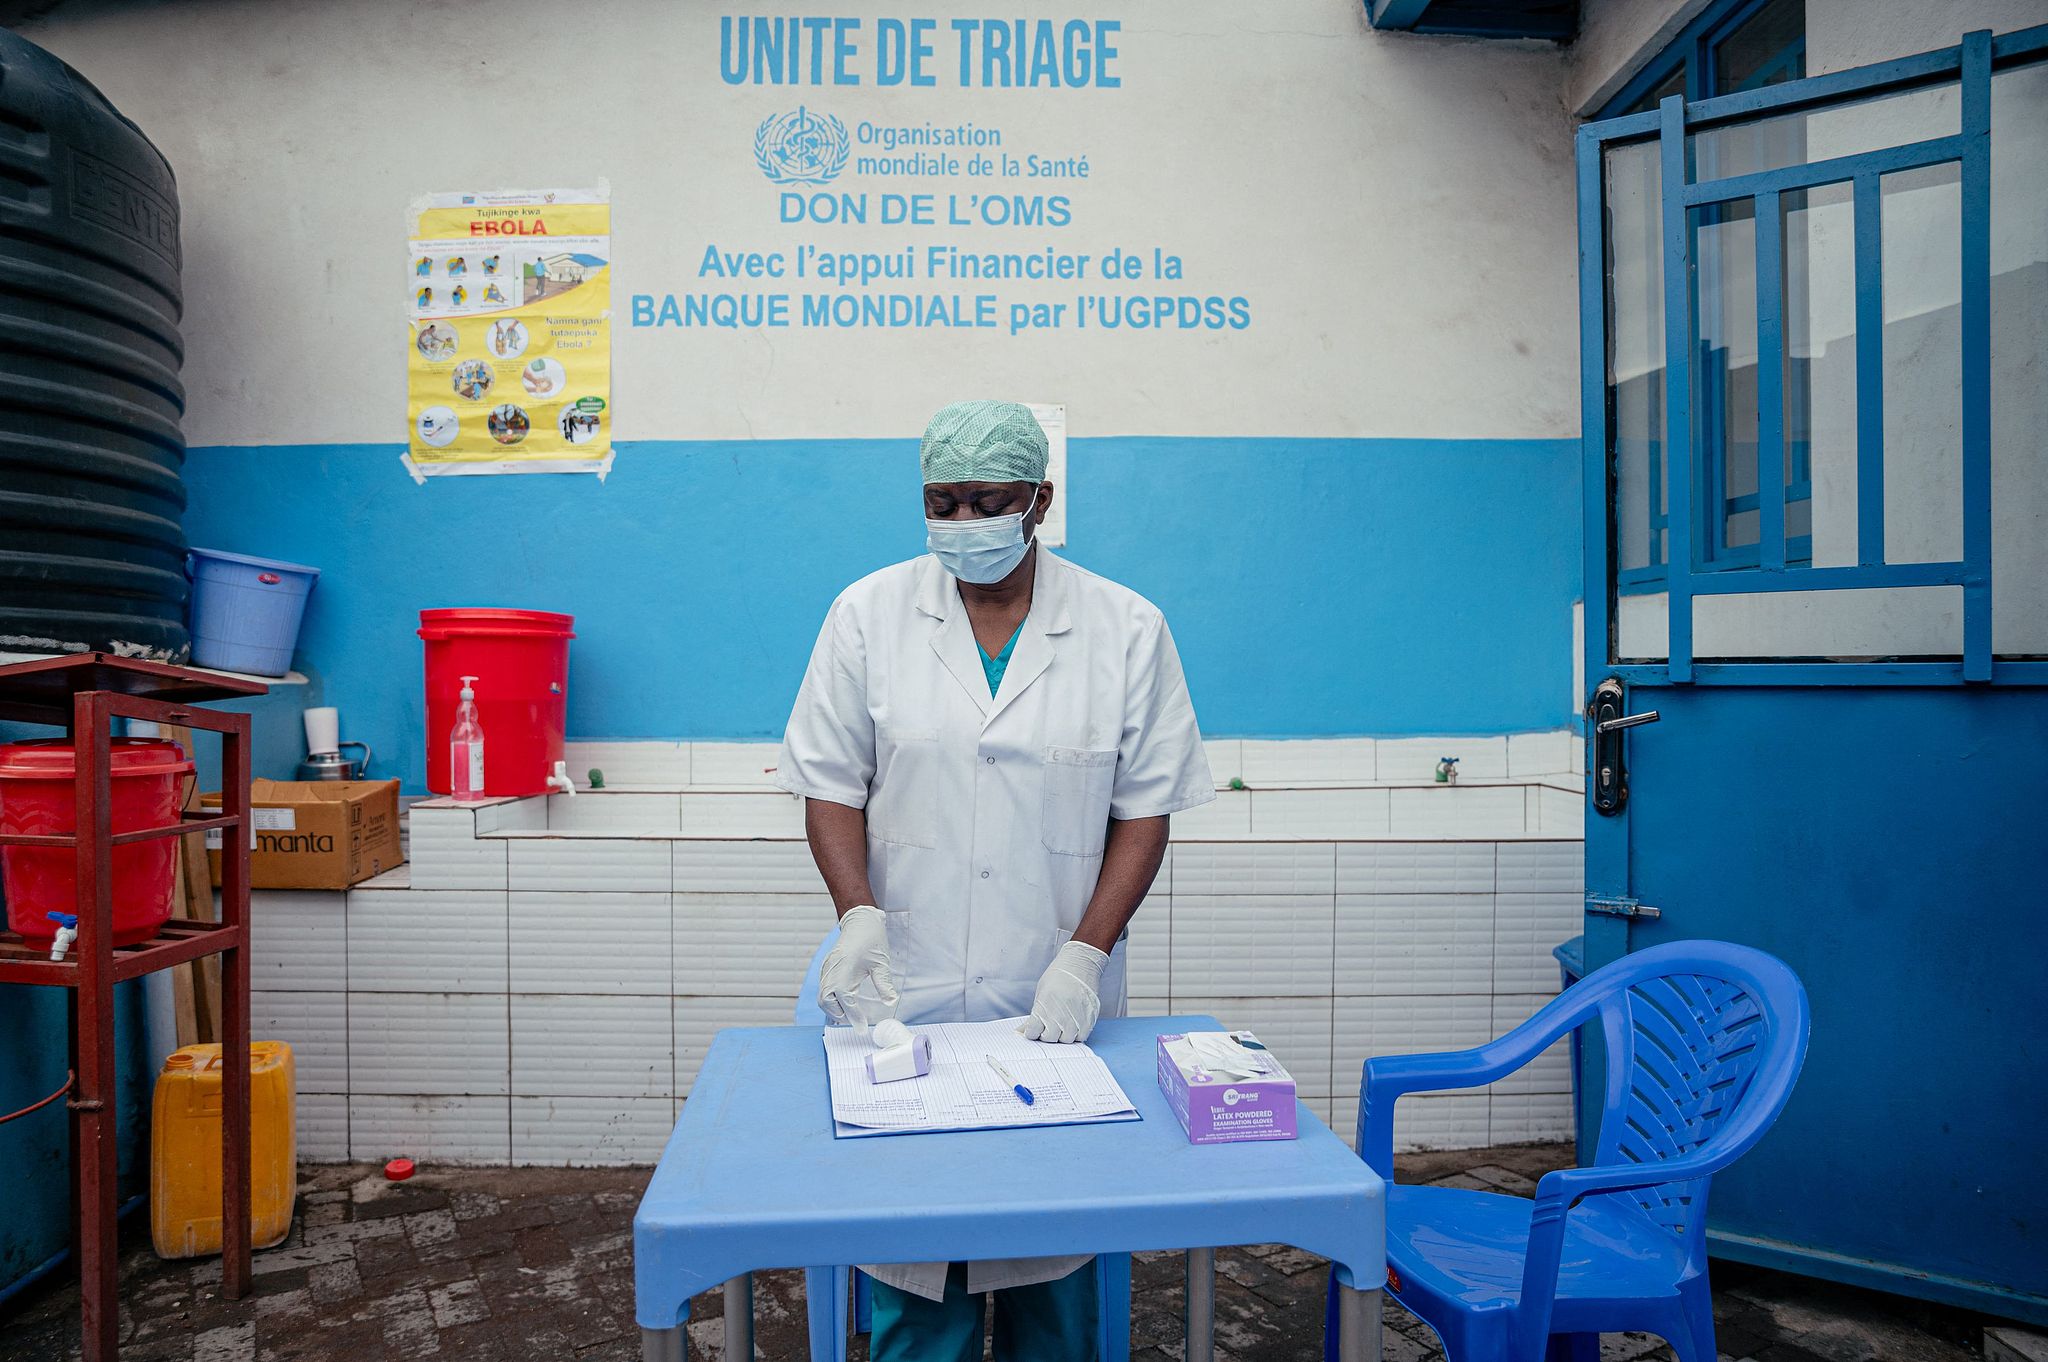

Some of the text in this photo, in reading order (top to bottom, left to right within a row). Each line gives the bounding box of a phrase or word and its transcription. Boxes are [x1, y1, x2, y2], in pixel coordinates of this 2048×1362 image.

[720, 16, 1121, 88] UNITE DE TRIAGE
[857, 121, 1001, 150] Organisation
[857, 153, 1089, 178] mondiale de la Santé
[477, 208, 540, 218] Tujikinge kwa
[780, 192, 1072, 227] DON DE L’OMS
[470, 219, 547, 236] EBOLA
[699, 244, 1182, 287] Avec l’appui Financier de la
[632, 294, 1250, 336] BANQUE MONDIALE par l’UGPDSS
[557, 340, 582, 348] Ebola
[1213, 1113, 1233, 1121] LATEX
[1235, 1110, 1273, 1119] POWDERED
